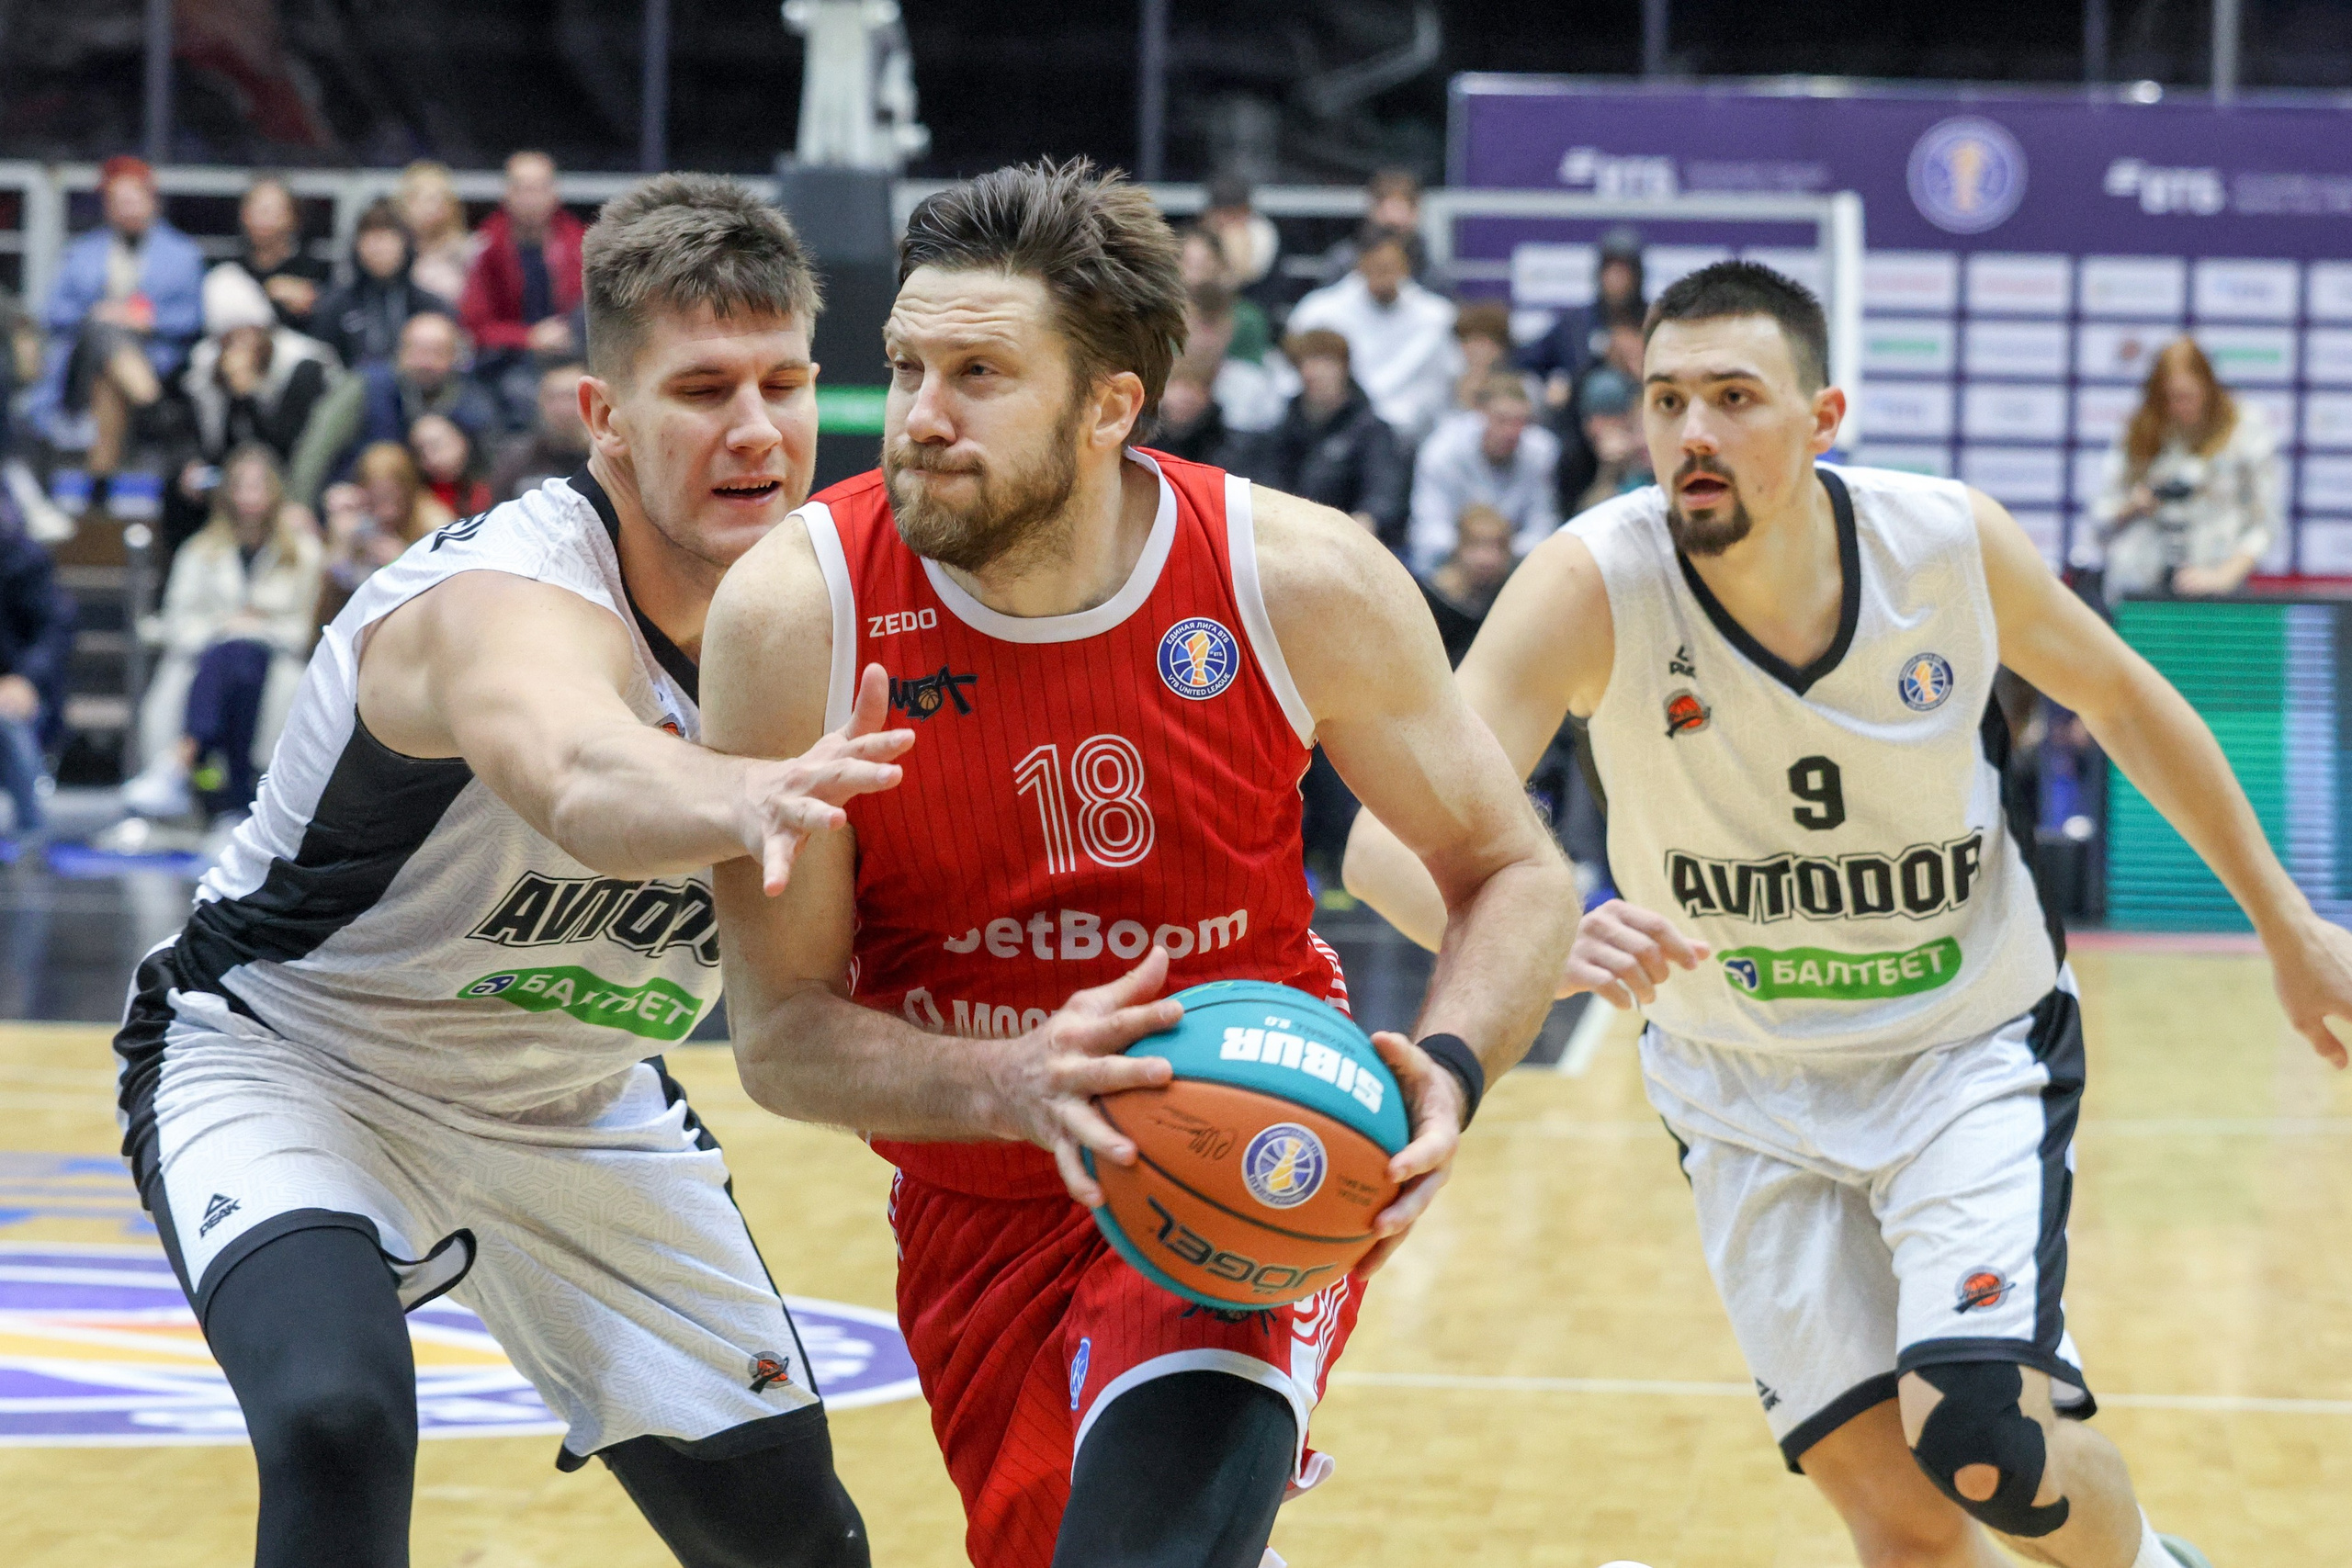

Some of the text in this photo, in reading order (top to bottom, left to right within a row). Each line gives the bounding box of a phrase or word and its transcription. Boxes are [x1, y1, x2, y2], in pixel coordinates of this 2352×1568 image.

[867, 607, 937, 638] ZEDO
[1165, 621, 1230, 645] ЕДИНАЯ ЛИГА ВТБ
[1167, 671, 1231, 696] VTB UNITED LEAGUE
[1012, 733, 1156, 875] 18
[1787, 755, 1846, 830] 9
[1772, 944, 1947, 987] БАЛТБЕТ
[1219, 1026, 1385, 1114] SIBUR
[199, 1198, 242, 1239] PEAK
